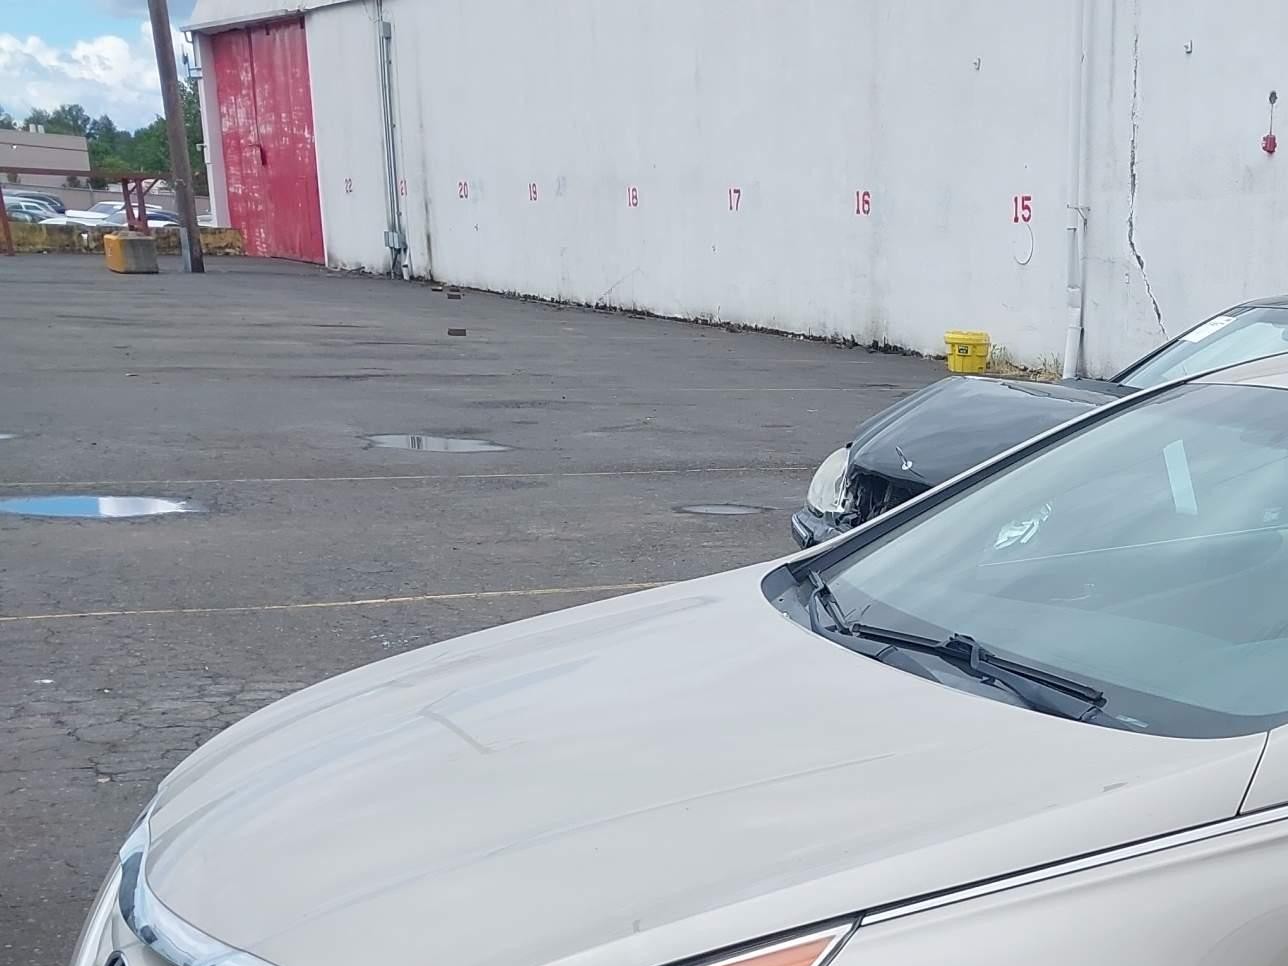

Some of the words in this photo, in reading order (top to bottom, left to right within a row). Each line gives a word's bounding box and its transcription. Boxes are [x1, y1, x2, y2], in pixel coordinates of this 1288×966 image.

[458, 181, 469, 199] 20
[528, 183, 538, 201] 19
[627, 186, 639, 208] 18
[728, 188, 741, 212] 17
[855, 190, 871, 215] 16
[1012, 194, 1032, 223] 15
